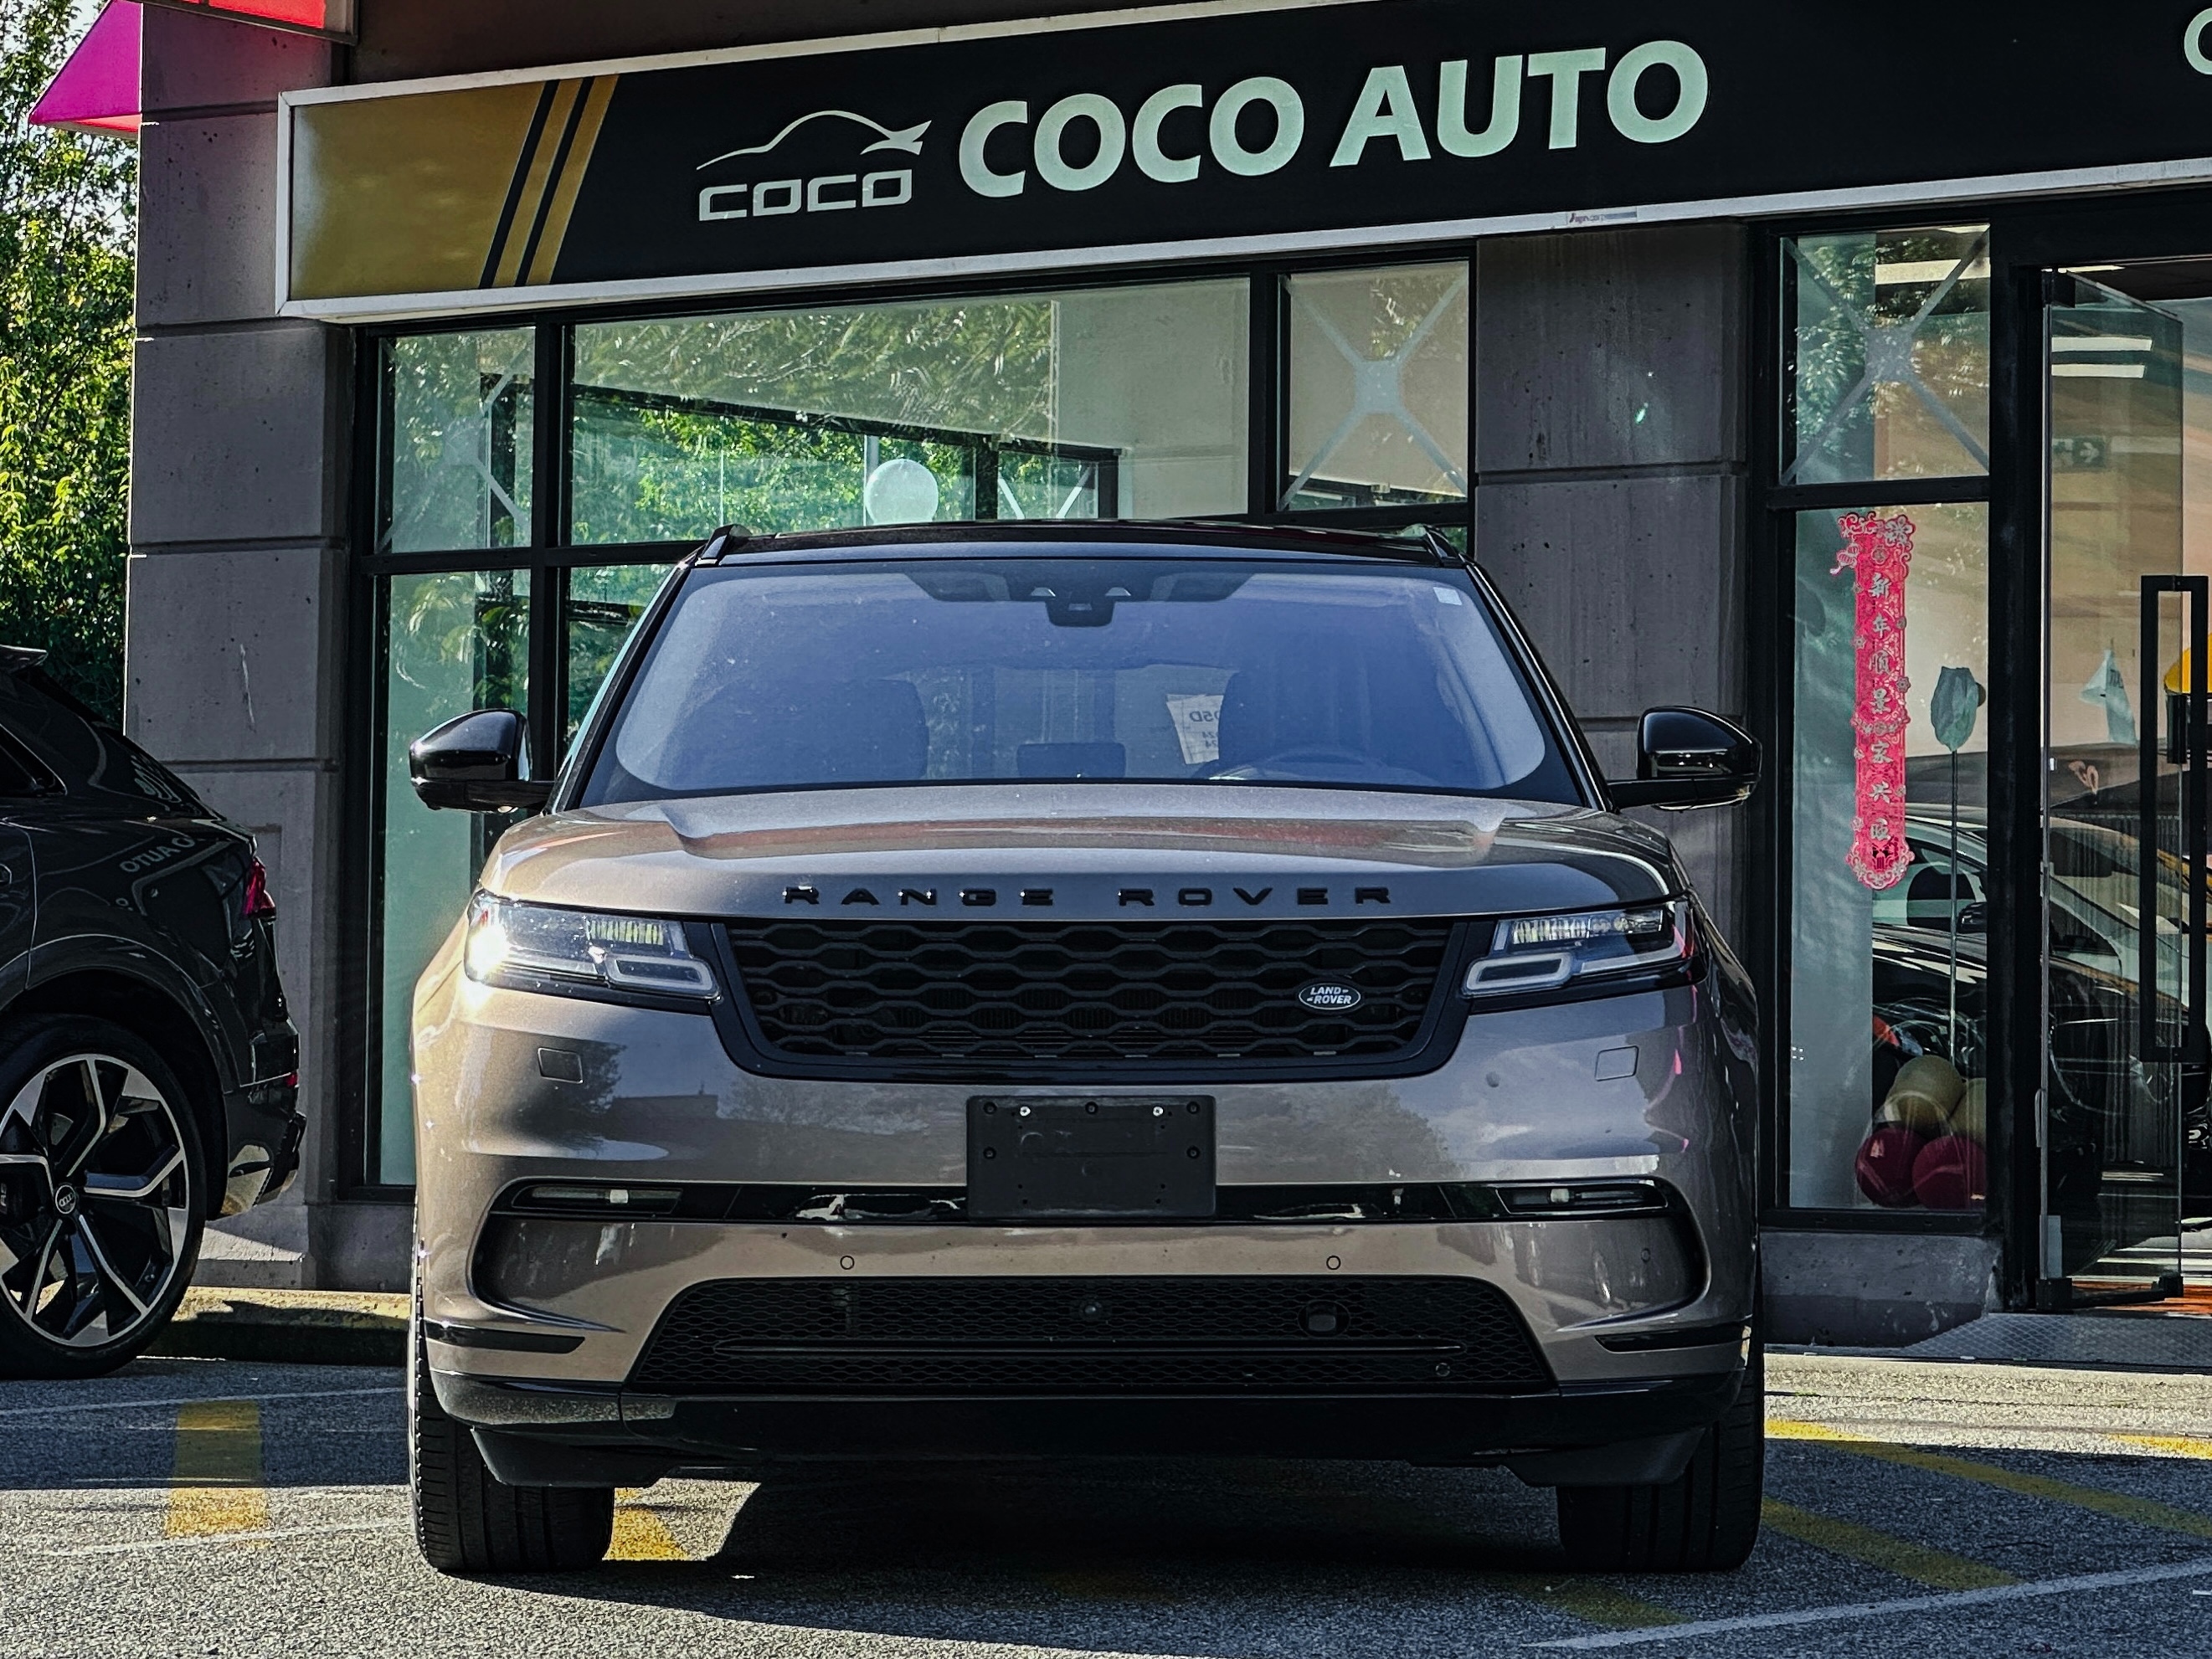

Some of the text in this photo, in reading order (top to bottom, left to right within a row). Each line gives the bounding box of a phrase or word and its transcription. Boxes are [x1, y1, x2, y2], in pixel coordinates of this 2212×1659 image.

[959, 40, 1709, 198] COCO AUTO
[698, 168, 913, 221] COCO
[784, 886, 1392, 907] RANGE ROVER
[1310, 987, 1341, 995] LAND
[1313, 995, 1352, 1004] ROVER
